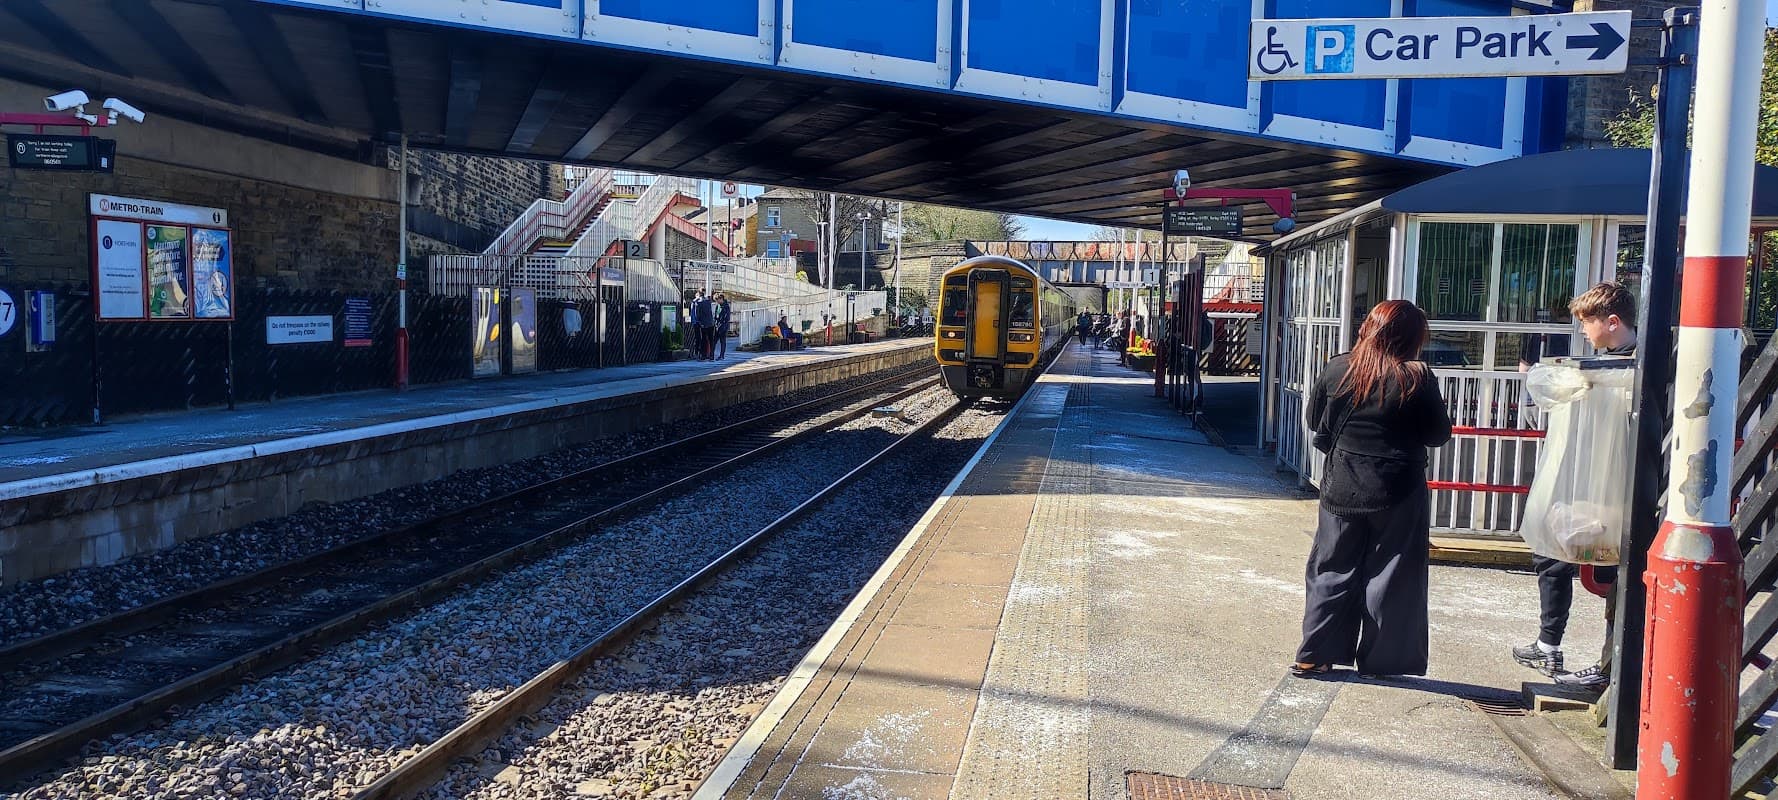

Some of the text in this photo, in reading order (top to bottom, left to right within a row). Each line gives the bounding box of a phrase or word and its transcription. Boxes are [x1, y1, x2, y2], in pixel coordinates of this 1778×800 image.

[1365, 28, 1438, 60] Car
[1455, 24, 1553, 59] Park
[631, 244, 641, 257] 2
[1149, 272, 1154, 281] 1
[0, 302, 12, 321] 7
